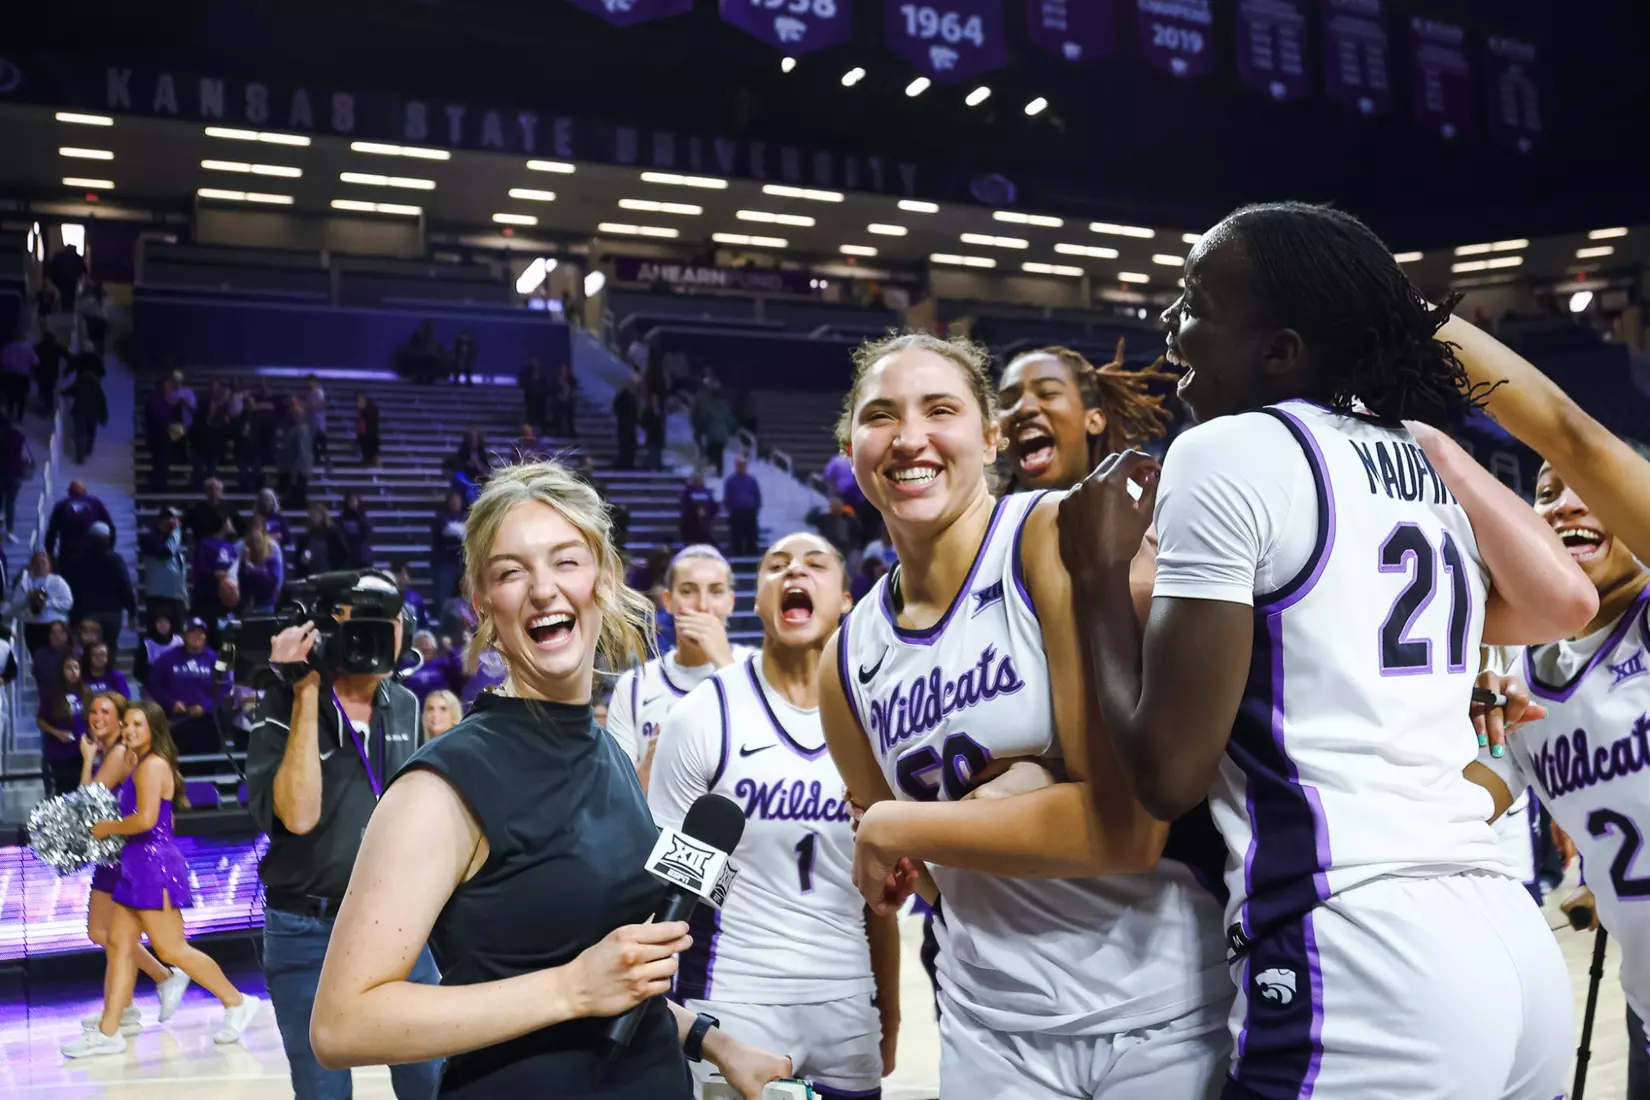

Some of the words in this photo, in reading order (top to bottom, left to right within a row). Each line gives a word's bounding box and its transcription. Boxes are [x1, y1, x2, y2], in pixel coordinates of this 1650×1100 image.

[901, 4, 984, 47] 1964
[1152, 23, 1205, 54] 2019
[105, 66, 356, 132] KANSAS
[404, 101, 575, 158] STATE
[1378, 520, 1473, 677] 21
[870, 642, 1027, 758] Wildcats
[661, 833, 716, 879] XII
[793, 831, 820, 896] 1
